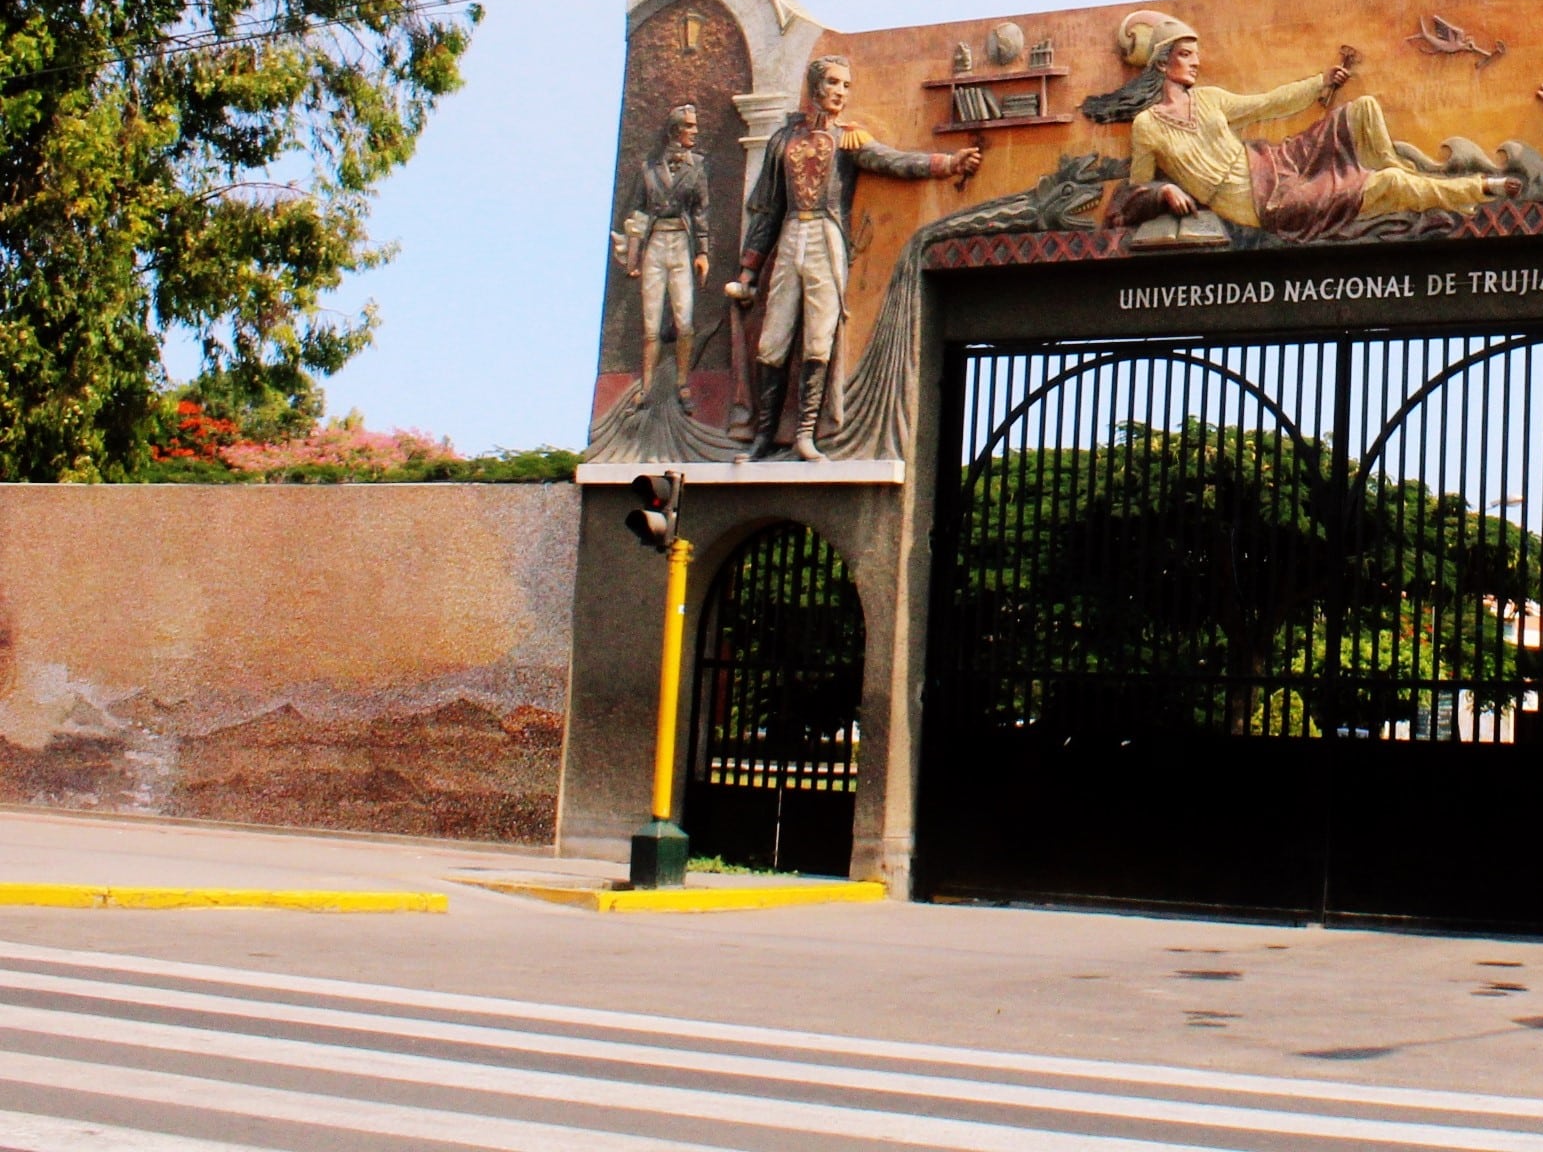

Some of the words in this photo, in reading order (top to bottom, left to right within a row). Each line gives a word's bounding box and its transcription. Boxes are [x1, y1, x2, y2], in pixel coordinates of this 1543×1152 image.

[1119, 280, 1275, 310] UNIVERSIDAD
[1283, 274, 1415, 302] NACIONAL
[1427, 272, 1457, 296] DE
